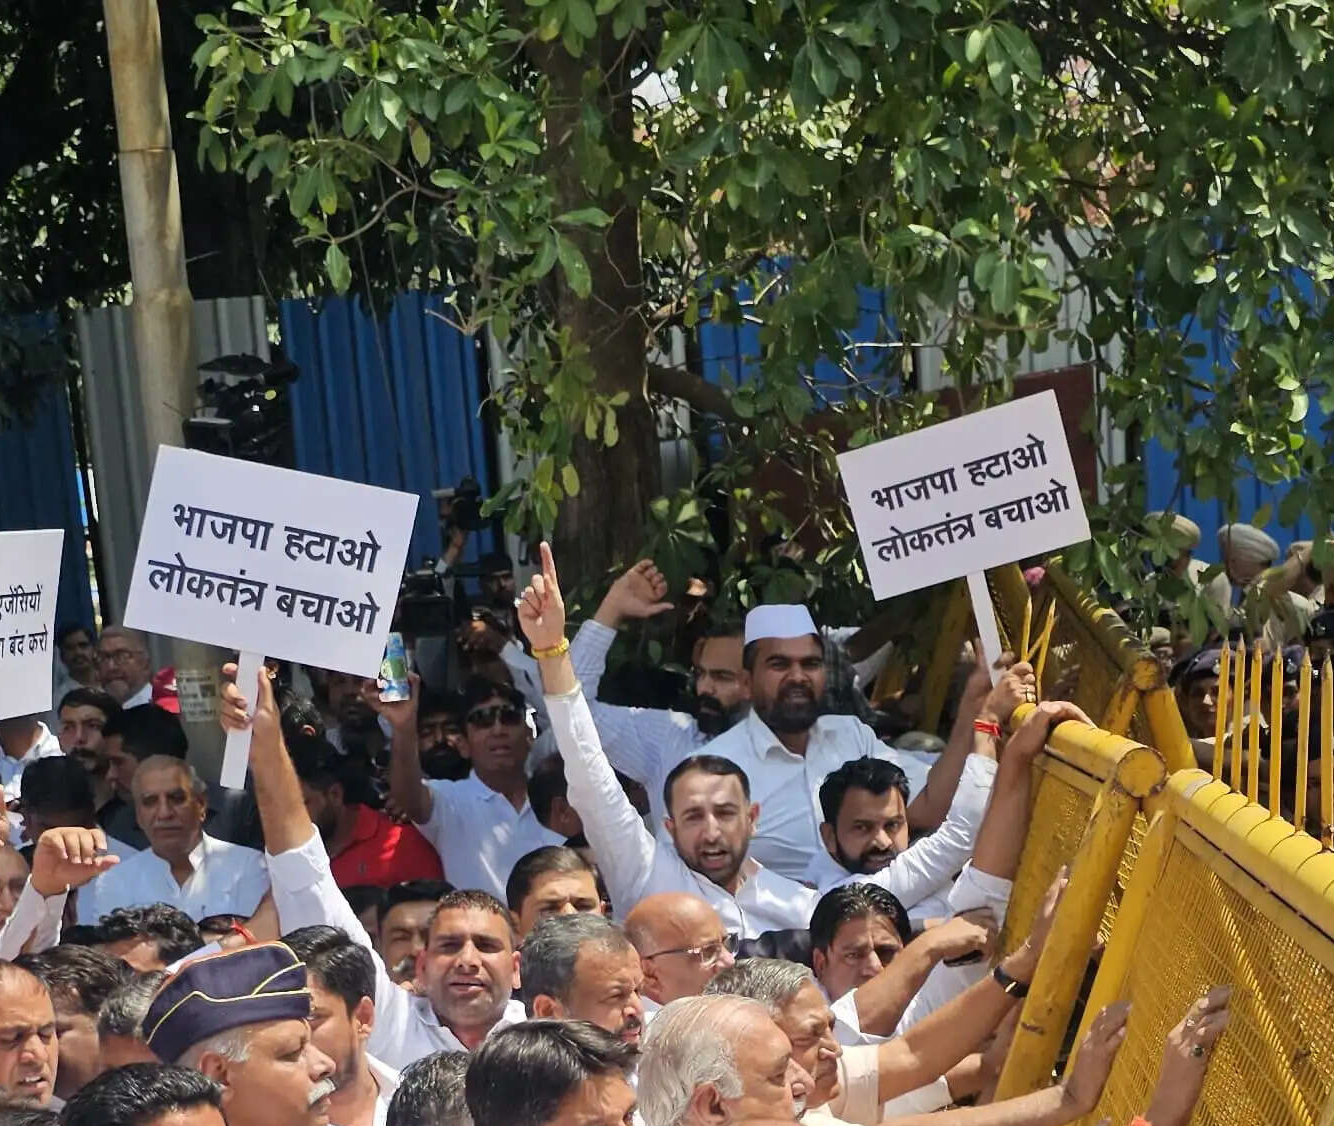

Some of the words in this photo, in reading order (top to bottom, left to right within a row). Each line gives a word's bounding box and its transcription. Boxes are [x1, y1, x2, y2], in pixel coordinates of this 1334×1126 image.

[871, 468, 958, 511] भाजपा
[964, 433, 1047, 486] हटाओ
[173, 503, 273, 552] भाजपा
[284, 525, 381, 573] हटाओ
[872, 512, 976, 562] लोकतंत्र
[979, 478, 1070, 531] बचाओ
[148, 552, 267, 612] लोकतंत्र
[276, 585, 380, 635] बचाओ
[9, 628, 25, 657] बंद
[29, 624, 48, 652] करो
